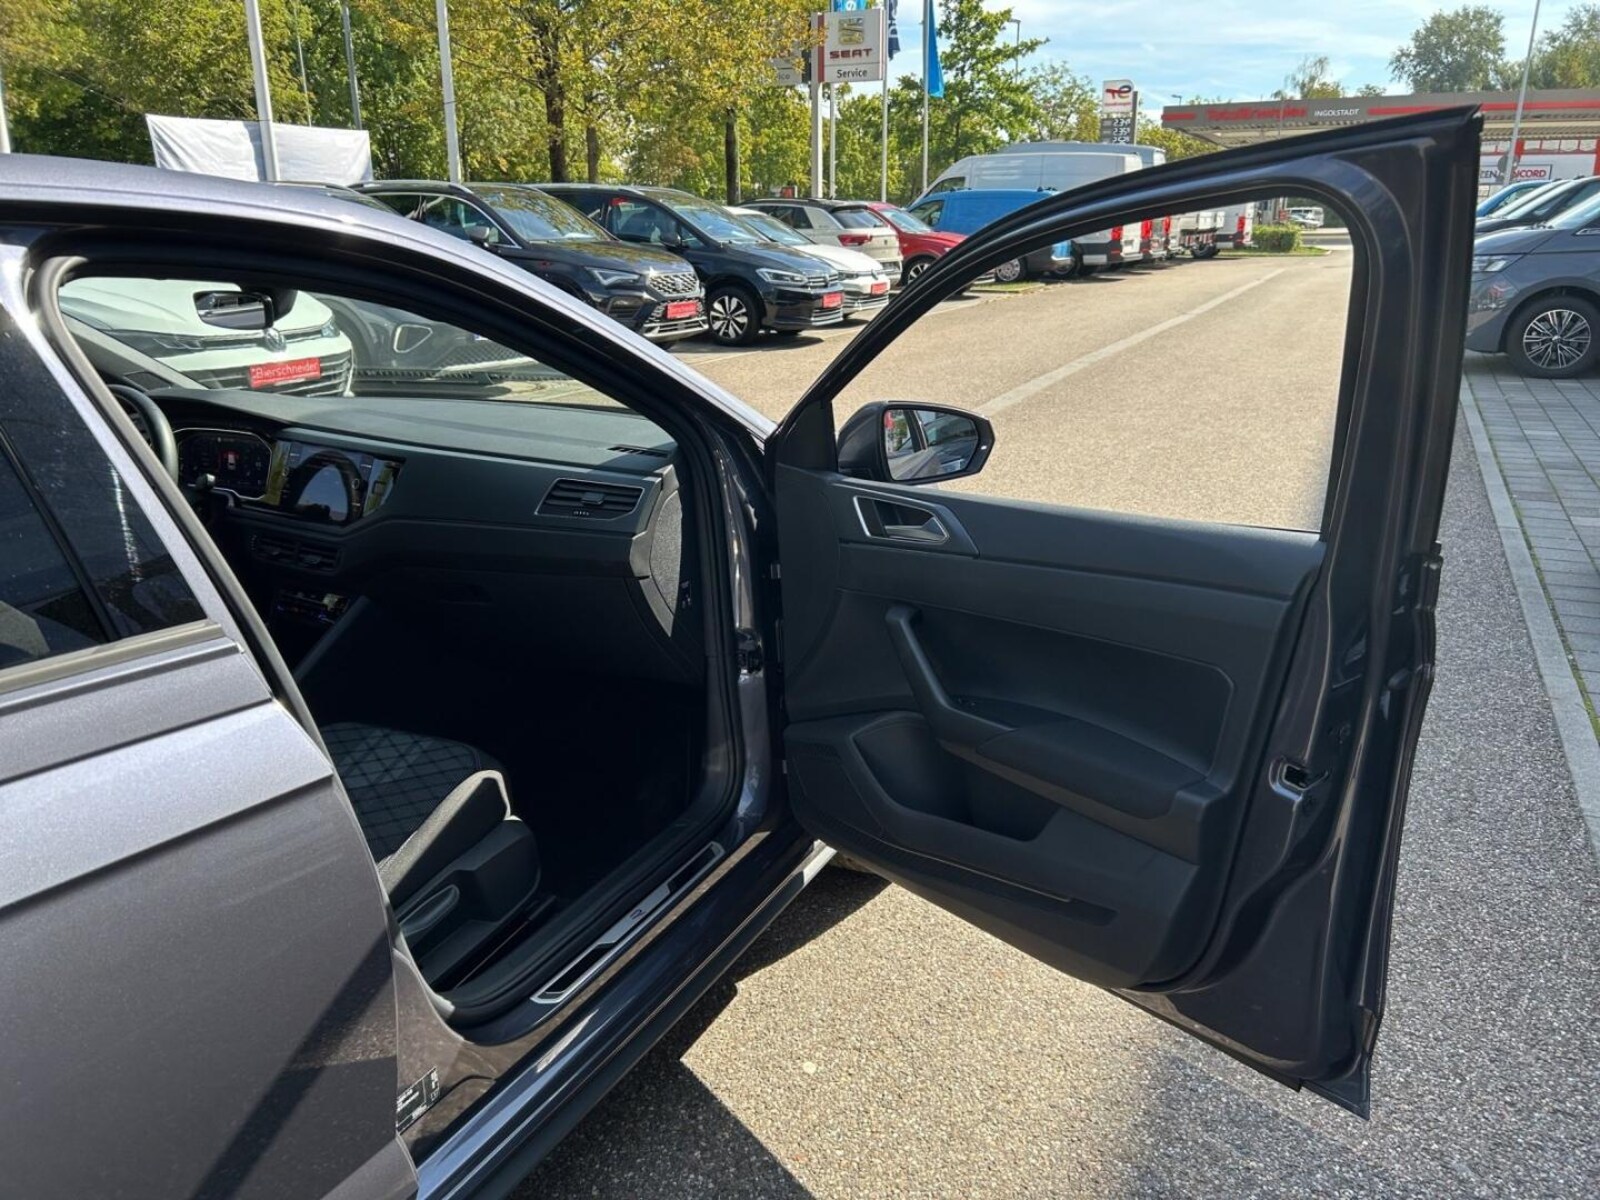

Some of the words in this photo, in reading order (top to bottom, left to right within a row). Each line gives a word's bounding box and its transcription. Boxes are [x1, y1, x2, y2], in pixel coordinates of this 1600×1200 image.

[829, 48, 872, 59] SEAT
[836, 68, 868, 79] Service
[1314, 108, 1360, 117] INGOLSTADT
